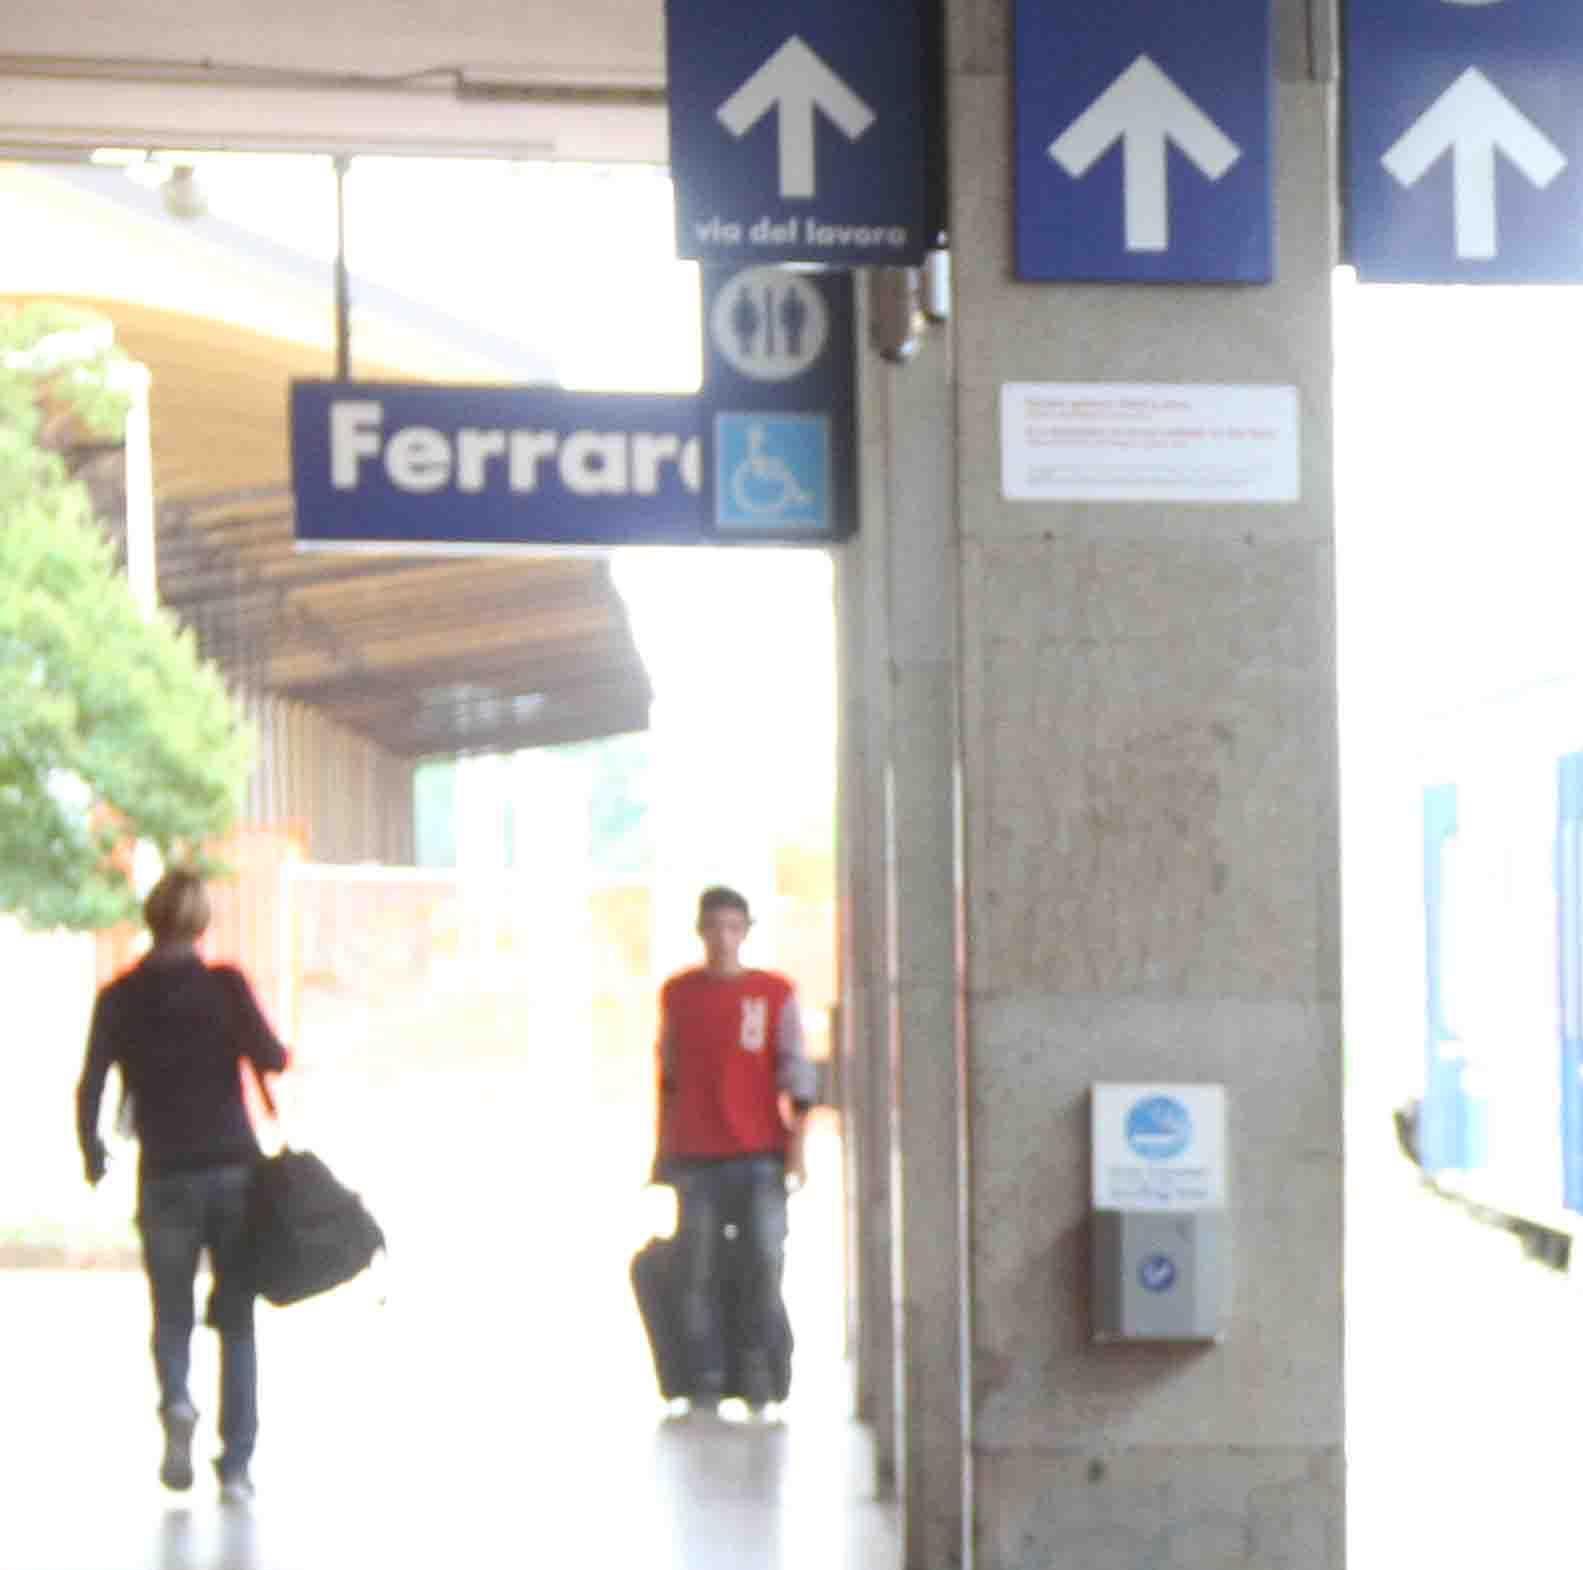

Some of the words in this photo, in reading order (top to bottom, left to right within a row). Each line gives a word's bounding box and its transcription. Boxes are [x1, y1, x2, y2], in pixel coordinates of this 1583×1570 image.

[697, 215, 741, 246] via
[750, 215, 797, 246] del
[806, 215, 908, 247] lavoro
